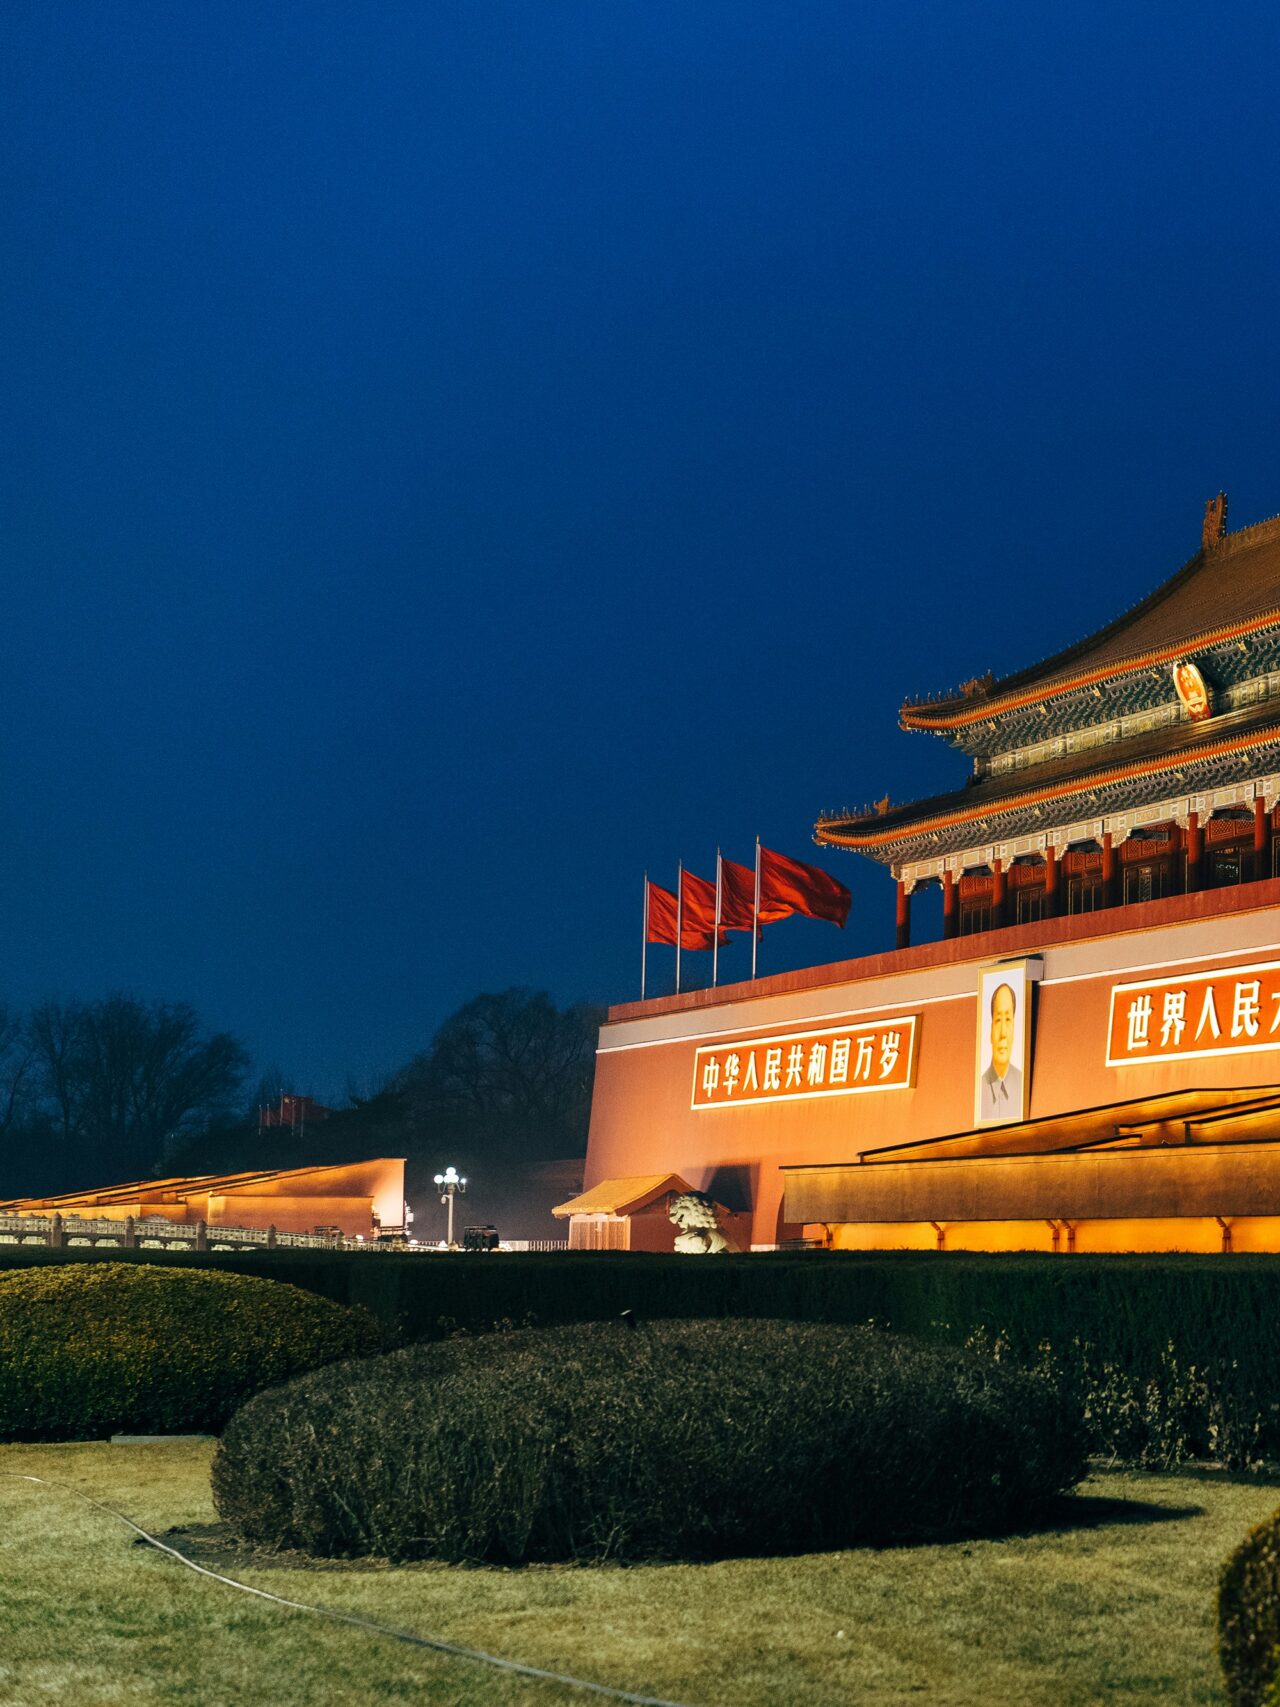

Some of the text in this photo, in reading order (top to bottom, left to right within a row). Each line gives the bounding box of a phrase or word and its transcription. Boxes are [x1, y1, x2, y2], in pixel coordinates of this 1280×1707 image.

[703, 1031, 901, 1098] 中华人民共和国万岁
